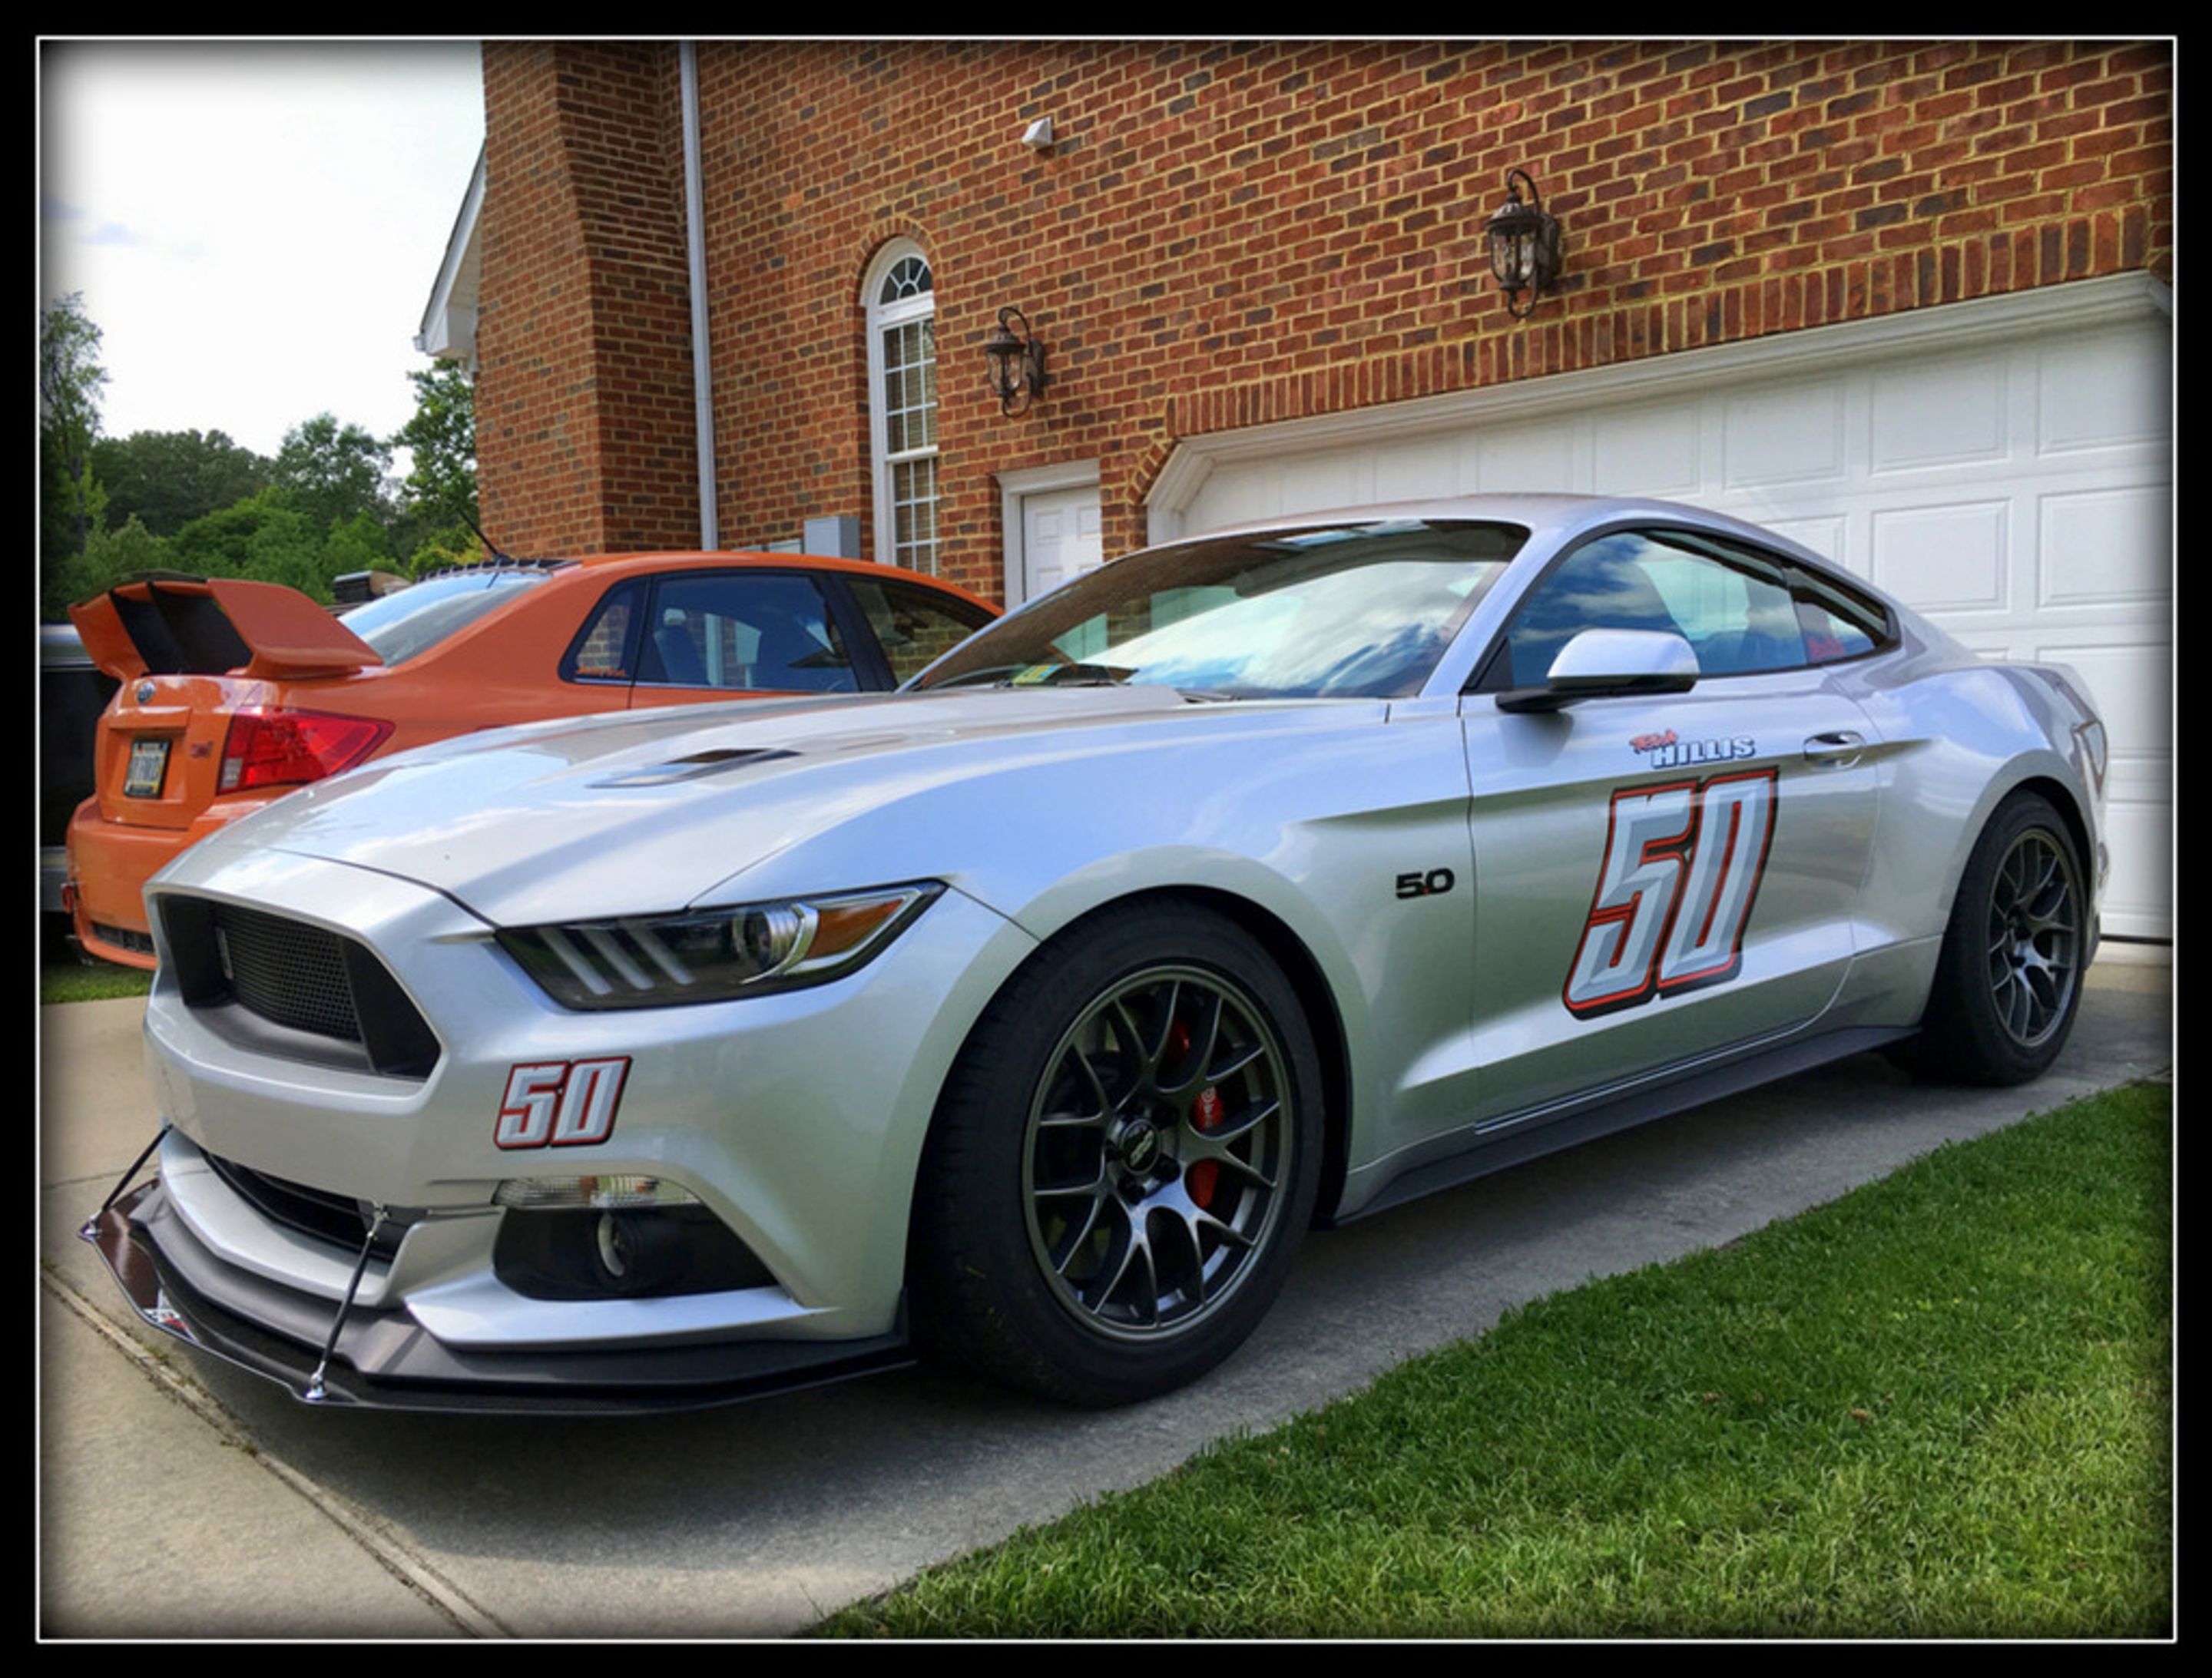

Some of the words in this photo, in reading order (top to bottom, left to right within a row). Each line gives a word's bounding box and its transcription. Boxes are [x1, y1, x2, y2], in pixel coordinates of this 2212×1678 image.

[1652, 736, 1757, 769] HILLIS
[1396, 868, 1455, 899] 5.0
[1563, 765, 1779, 1021] 50
[493, 1056, 633, 1150] 50
